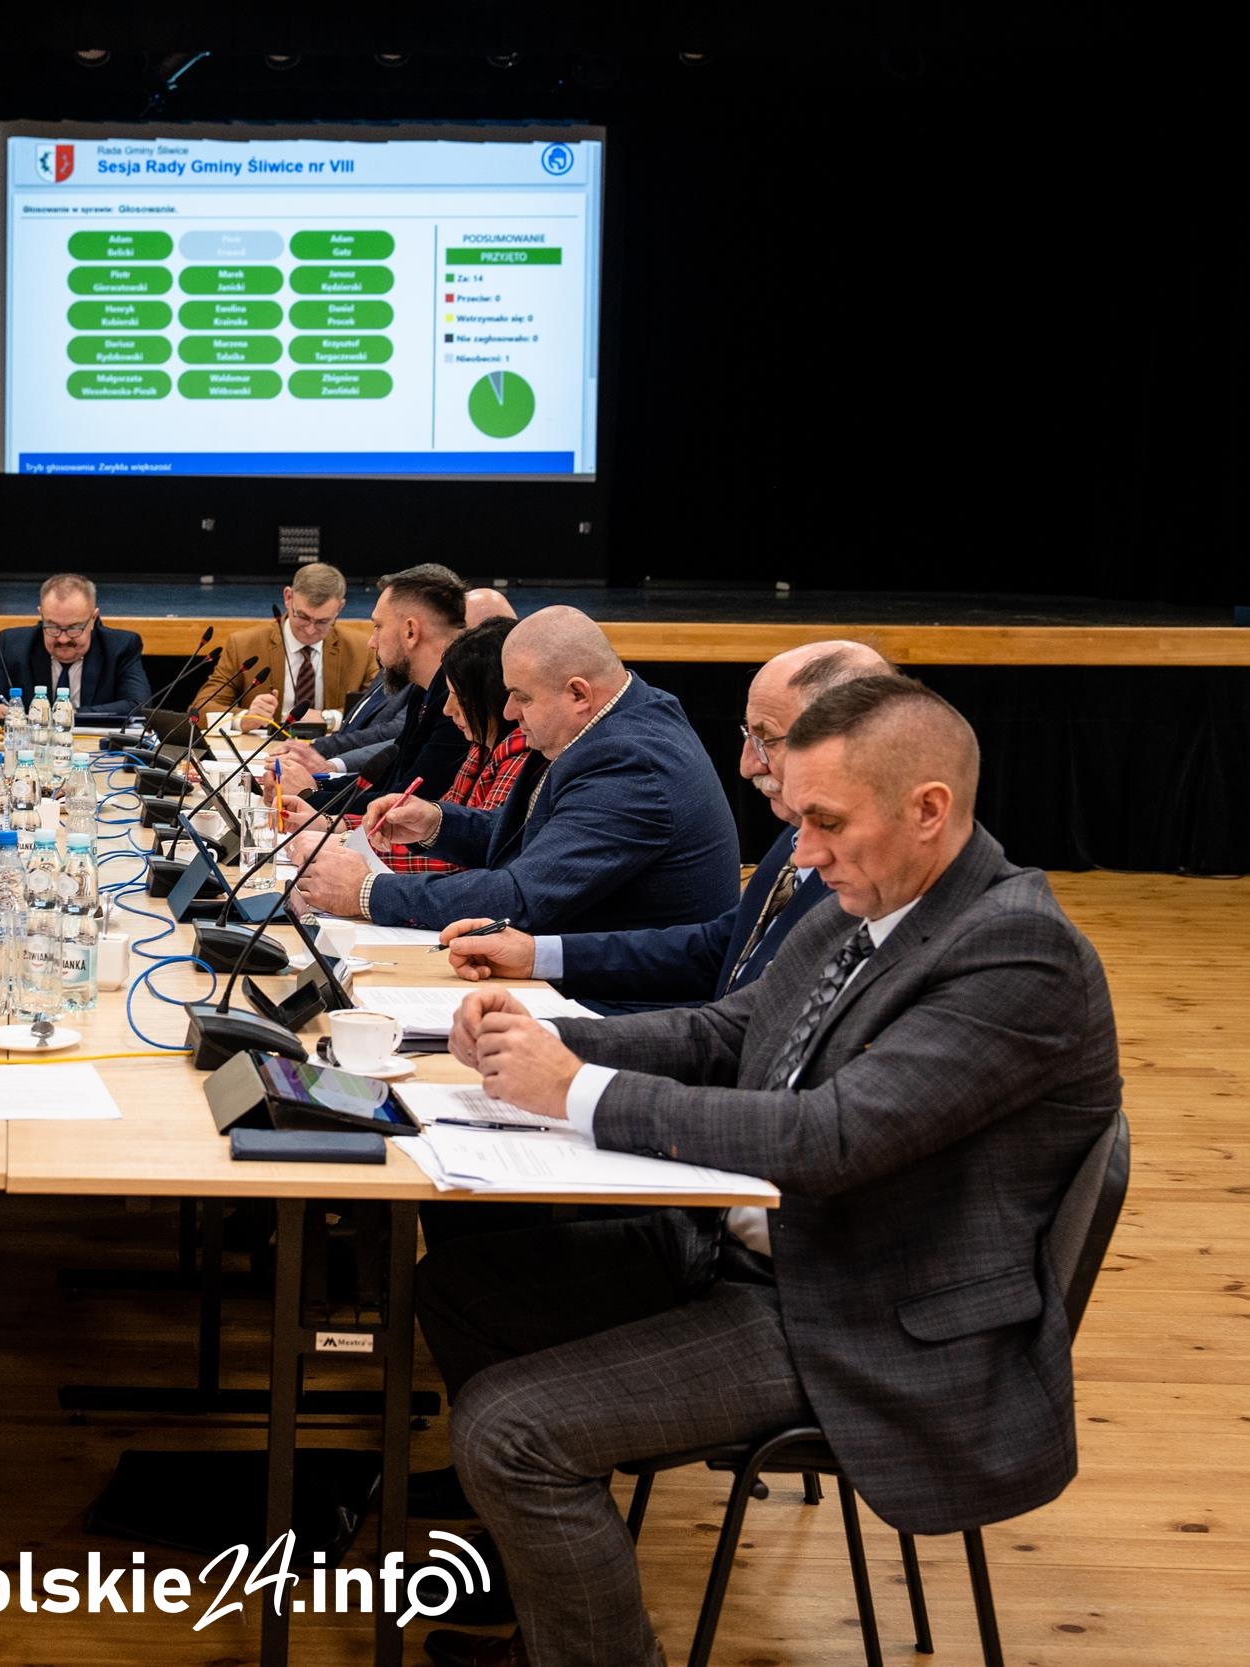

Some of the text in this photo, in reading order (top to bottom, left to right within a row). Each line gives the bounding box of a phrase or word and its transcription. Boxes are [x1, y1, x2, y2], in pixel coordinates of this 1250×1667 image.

[97, 144, 189, 156] Rada Gminy Śliwice
[97, 156, 355, 176] Sesja Rady Gminy Śliwice nr VIII
[108, 235, 133, 244] Adam
[330, 234, 354, 243] Adam
[462, 234, 545, 243] PODSUMOWANIE
[481, 251, 528, 263] PRZYJĘTO
[110, 270, 131, 279] Piotr
[218, 269, 244, 279] Marek
[328, 270, 355, 279] Janusz
[474, 274, 483, 282] 14
[495, 294, 501, 302] 0
[105, 305, 135, 316] Henryk
[215, 304, 247, 313] Ewelina
[328, 303, 355, 313] Daniel
[457, 314, 509, 324] Wstrzymało
[528, 314, 533, 322] 0
[456, 335, 470, 343] Nie
[533, 334, 538, 342] 0
[104, 339, 135, 349] Dariusz
[213, 339, 248, 348] Marzena
[322, 338, 360, 349] Krzysztof
[96, 374, 142, 384] Małgorzata
[209, 373, 250, 382] Waldemar
[322, 373, 359, 384] Zbigniew
